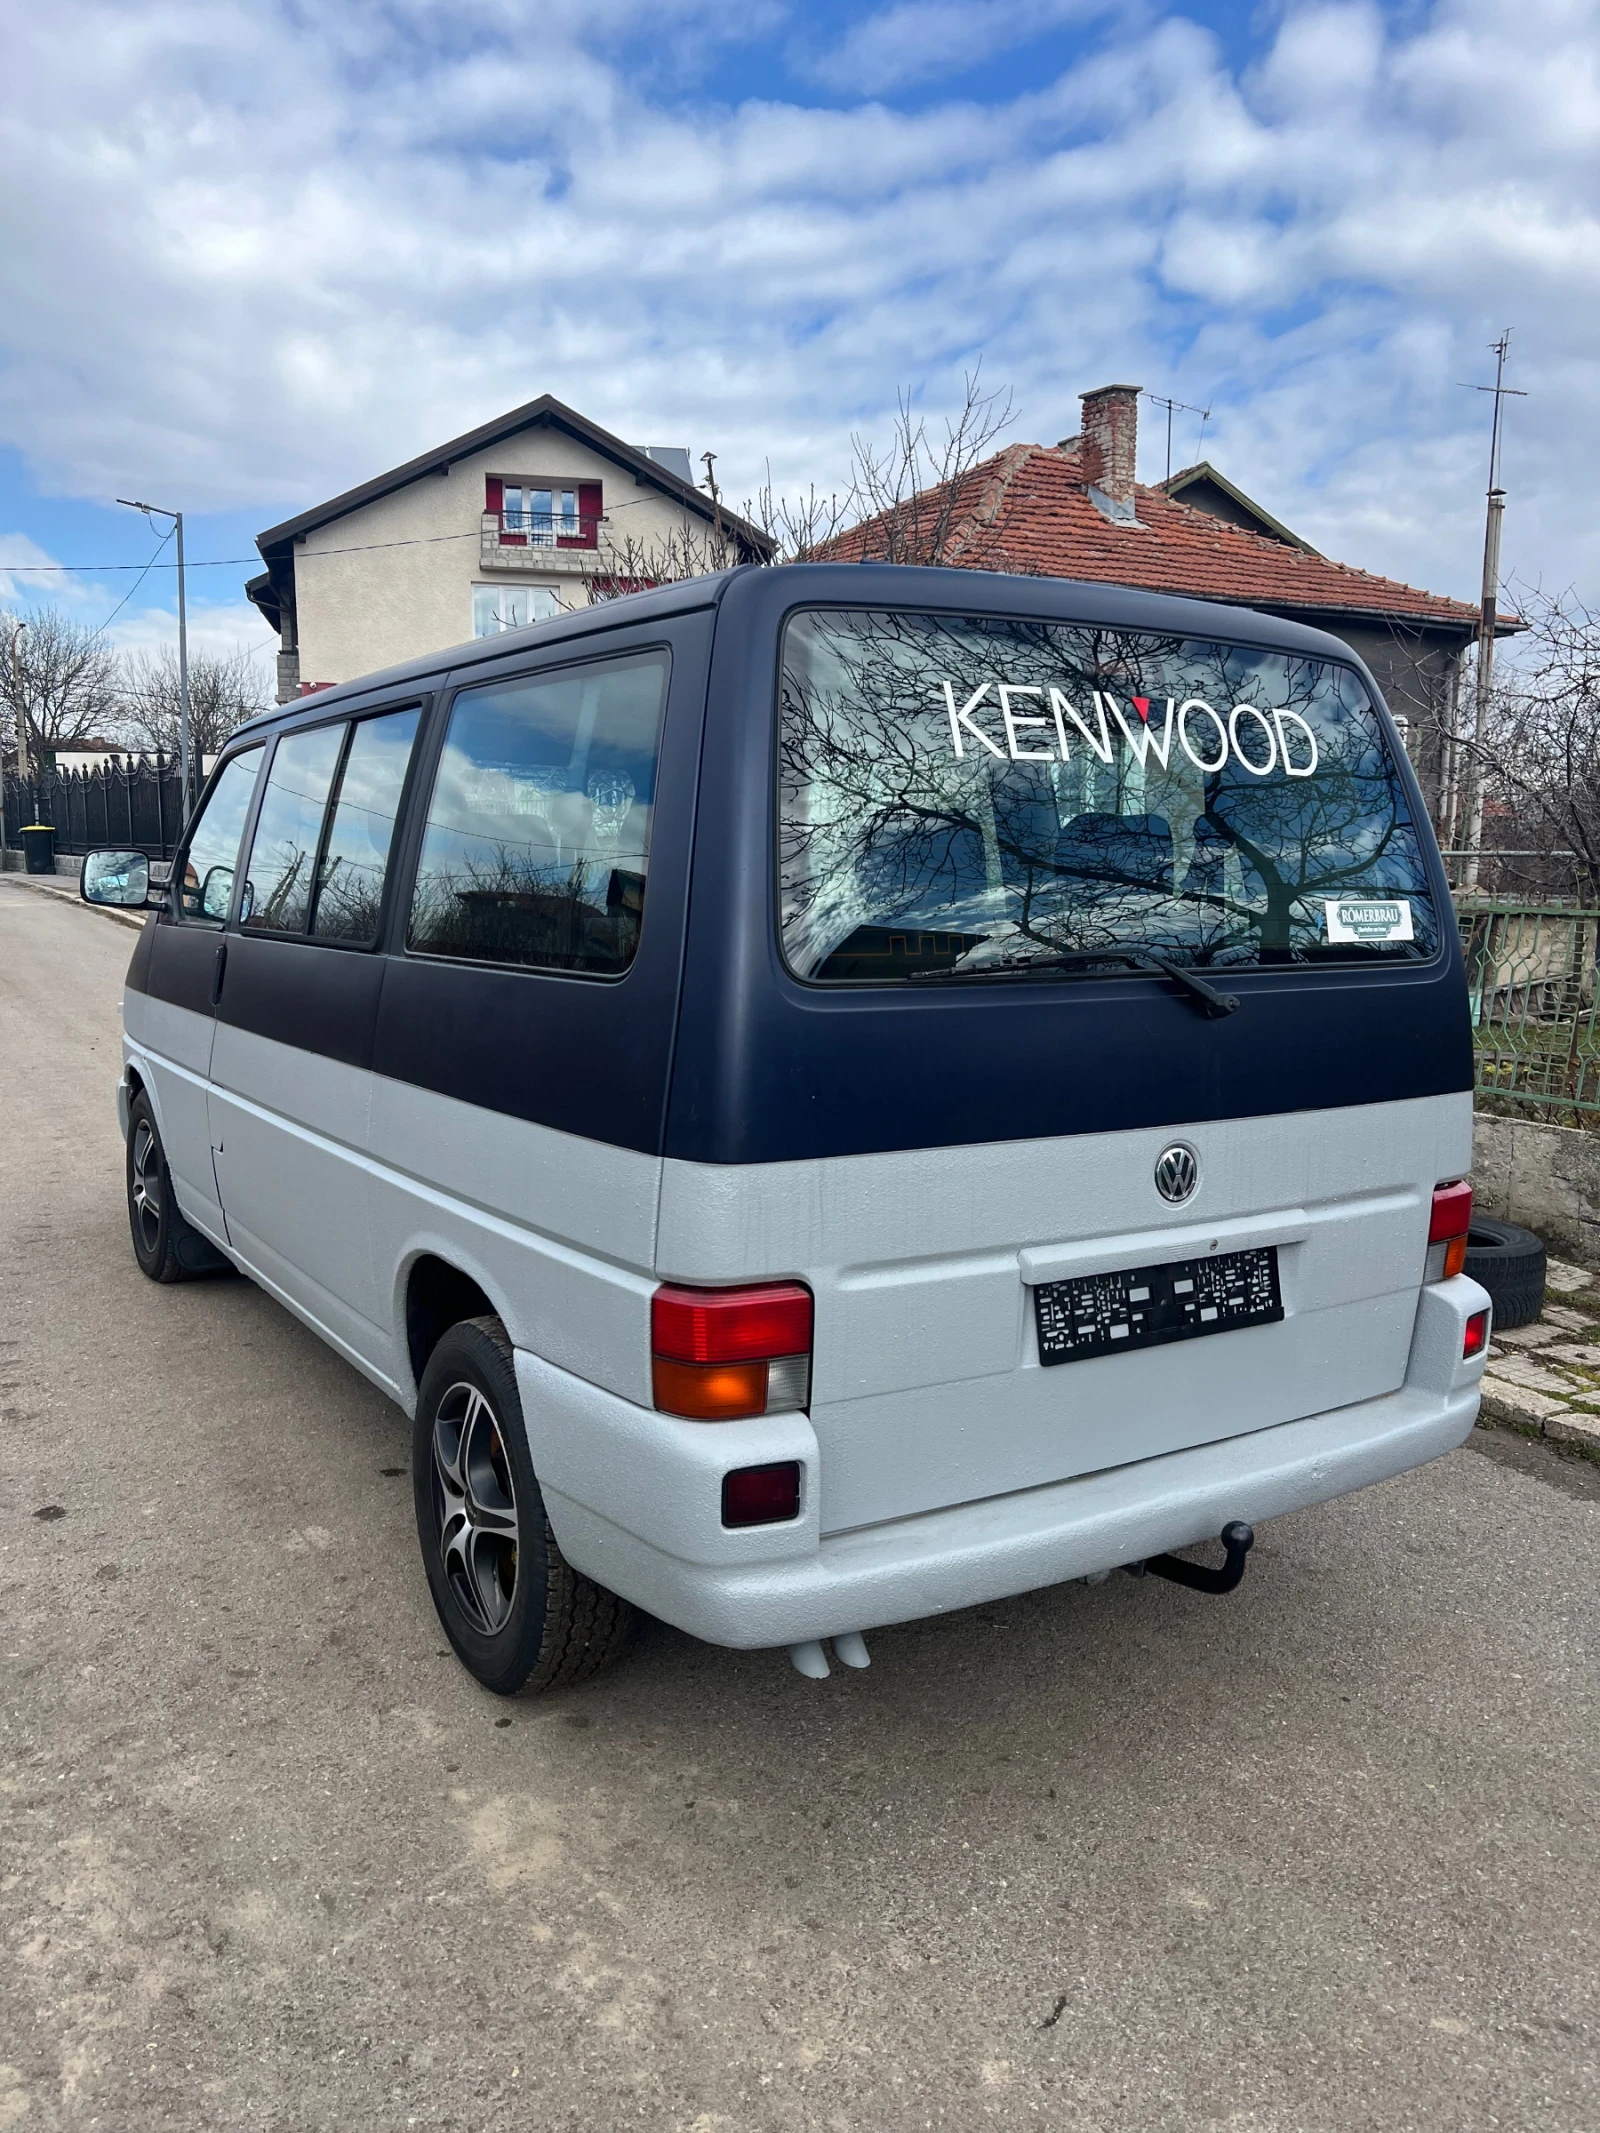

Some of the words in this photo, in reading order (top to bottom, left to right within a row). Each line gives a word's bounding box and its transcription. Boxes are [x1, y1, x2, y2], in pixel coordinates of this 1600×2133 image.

[943, 680, 1318, 777] KENWOOD
[1341, 906, 1398, 923] RÖMERBRÄU
[1157, 1147, 1197, 1202] VW
